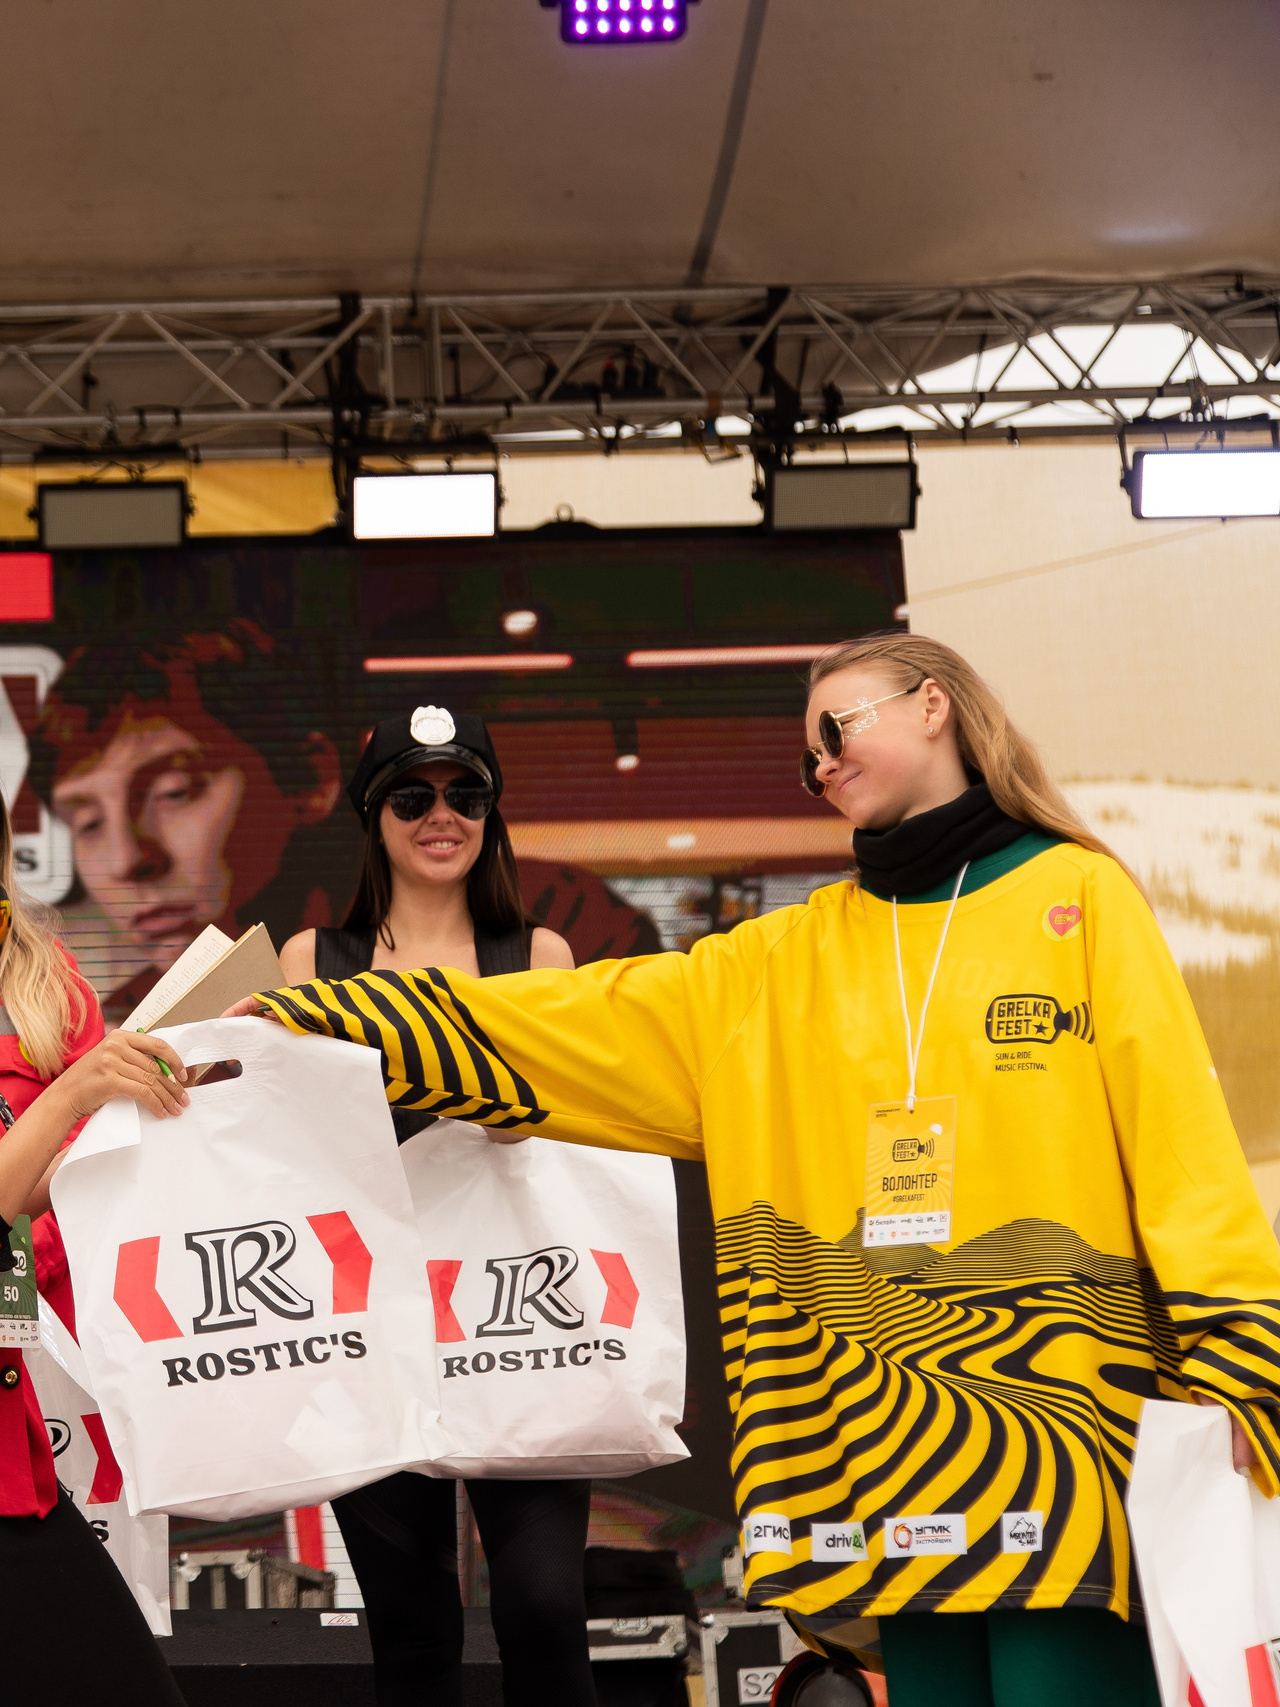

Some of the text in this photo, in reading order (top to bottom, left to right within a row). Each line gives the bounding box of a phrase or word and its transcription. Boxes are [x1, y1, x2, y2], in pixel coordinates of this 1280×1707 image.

[997, 1000, 1052, 1019] GRELKA
[996, 1019, 1033, 1036] FEST
[995, 1053, 1009, 1061] SUN
[1017, 1051, 1032, 1060] RIDE
[995, 1062, 1048, 1072] MUSIC FESTIVAL
[896, 1141, 918, 1151] GRELKA
[896, 1150, 910, 1159] FEST
[882, 1173, 938, 1192] ВОЛОНТЕР
[4, 1286, 19, 1302] 50
[162, 1330, 368, 1387] ROSTIC'S
[443, 1338, 627, 1379] ROSTIC'S
[753, 1525, 790, 1541] 2ГИС
[915, 1525, 952, 1535] УГМК
